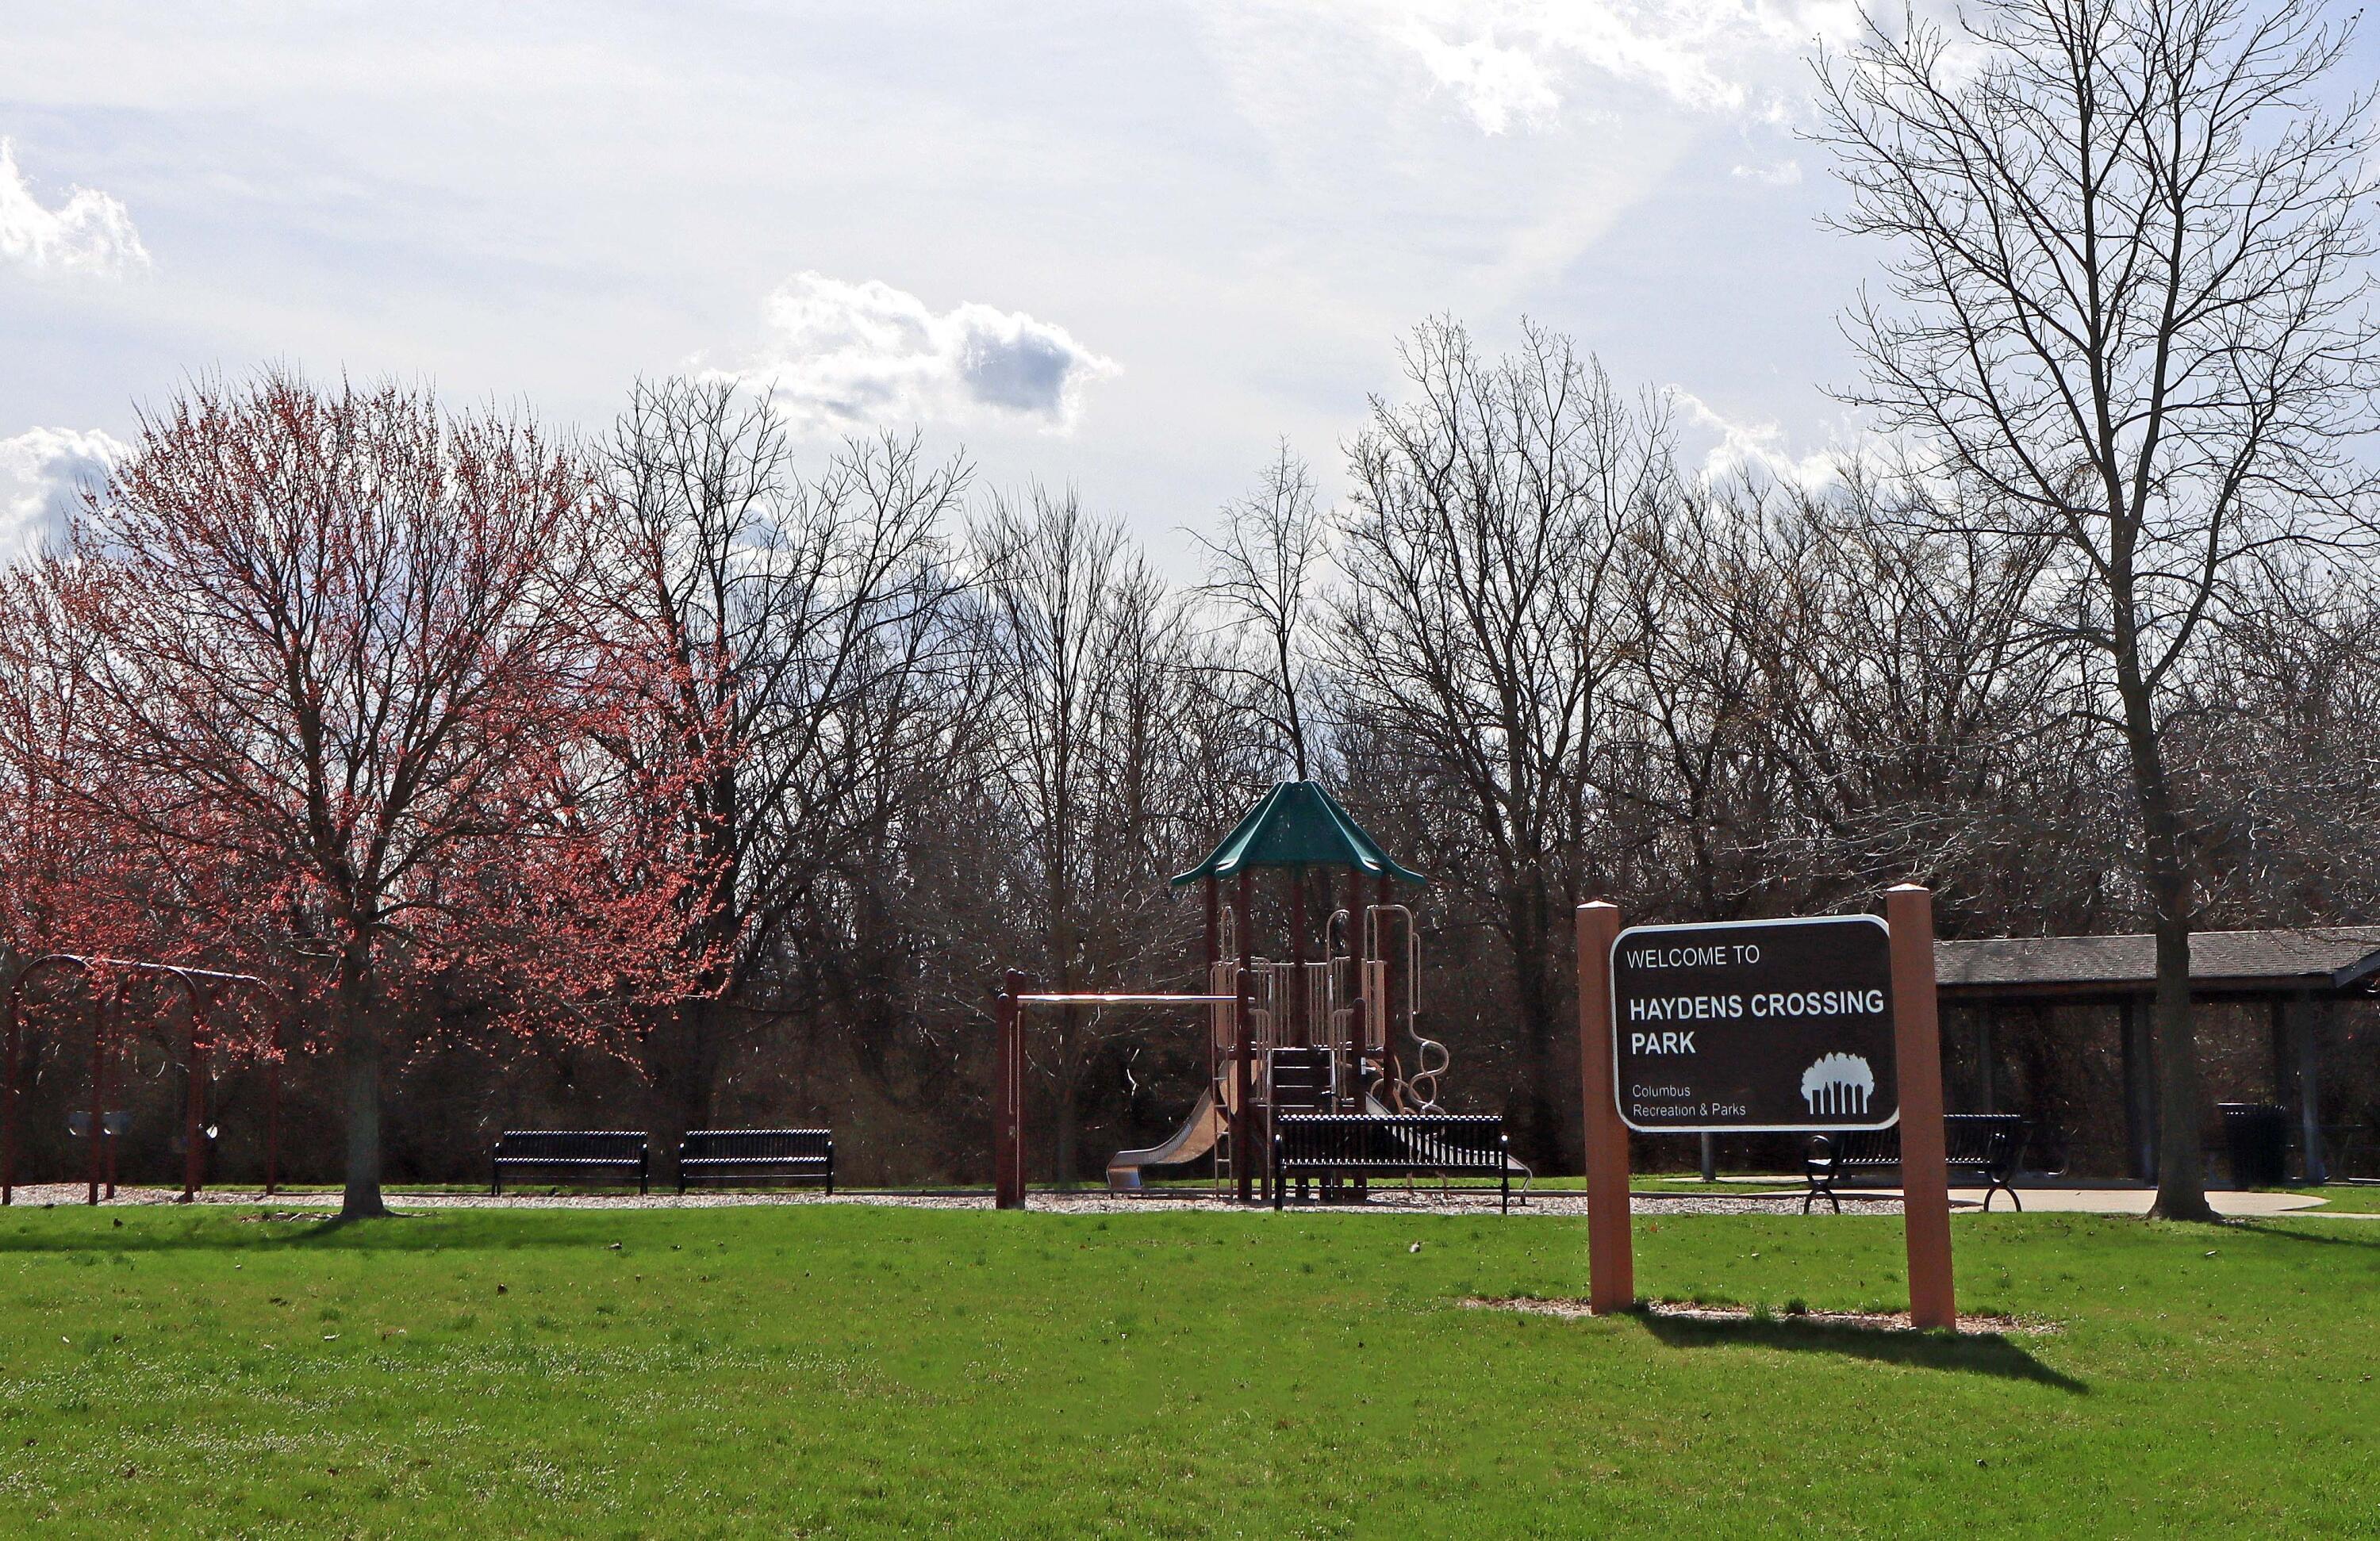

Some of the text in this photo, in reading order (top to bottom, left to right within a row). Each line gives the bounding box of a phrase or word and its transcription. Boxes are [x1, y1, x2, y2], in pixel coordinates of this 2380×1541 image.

[1626, 945, 1760, 969] WELCOME TO
[1630, 989, 1884, 1021] HAYDENS CROSSING
[1631, 1031, 1696, 1055] PARK
[1632, 1084, 1691, 1098] Columbus
[1633, 1102, 1746, 1117] Recreation & Parks
